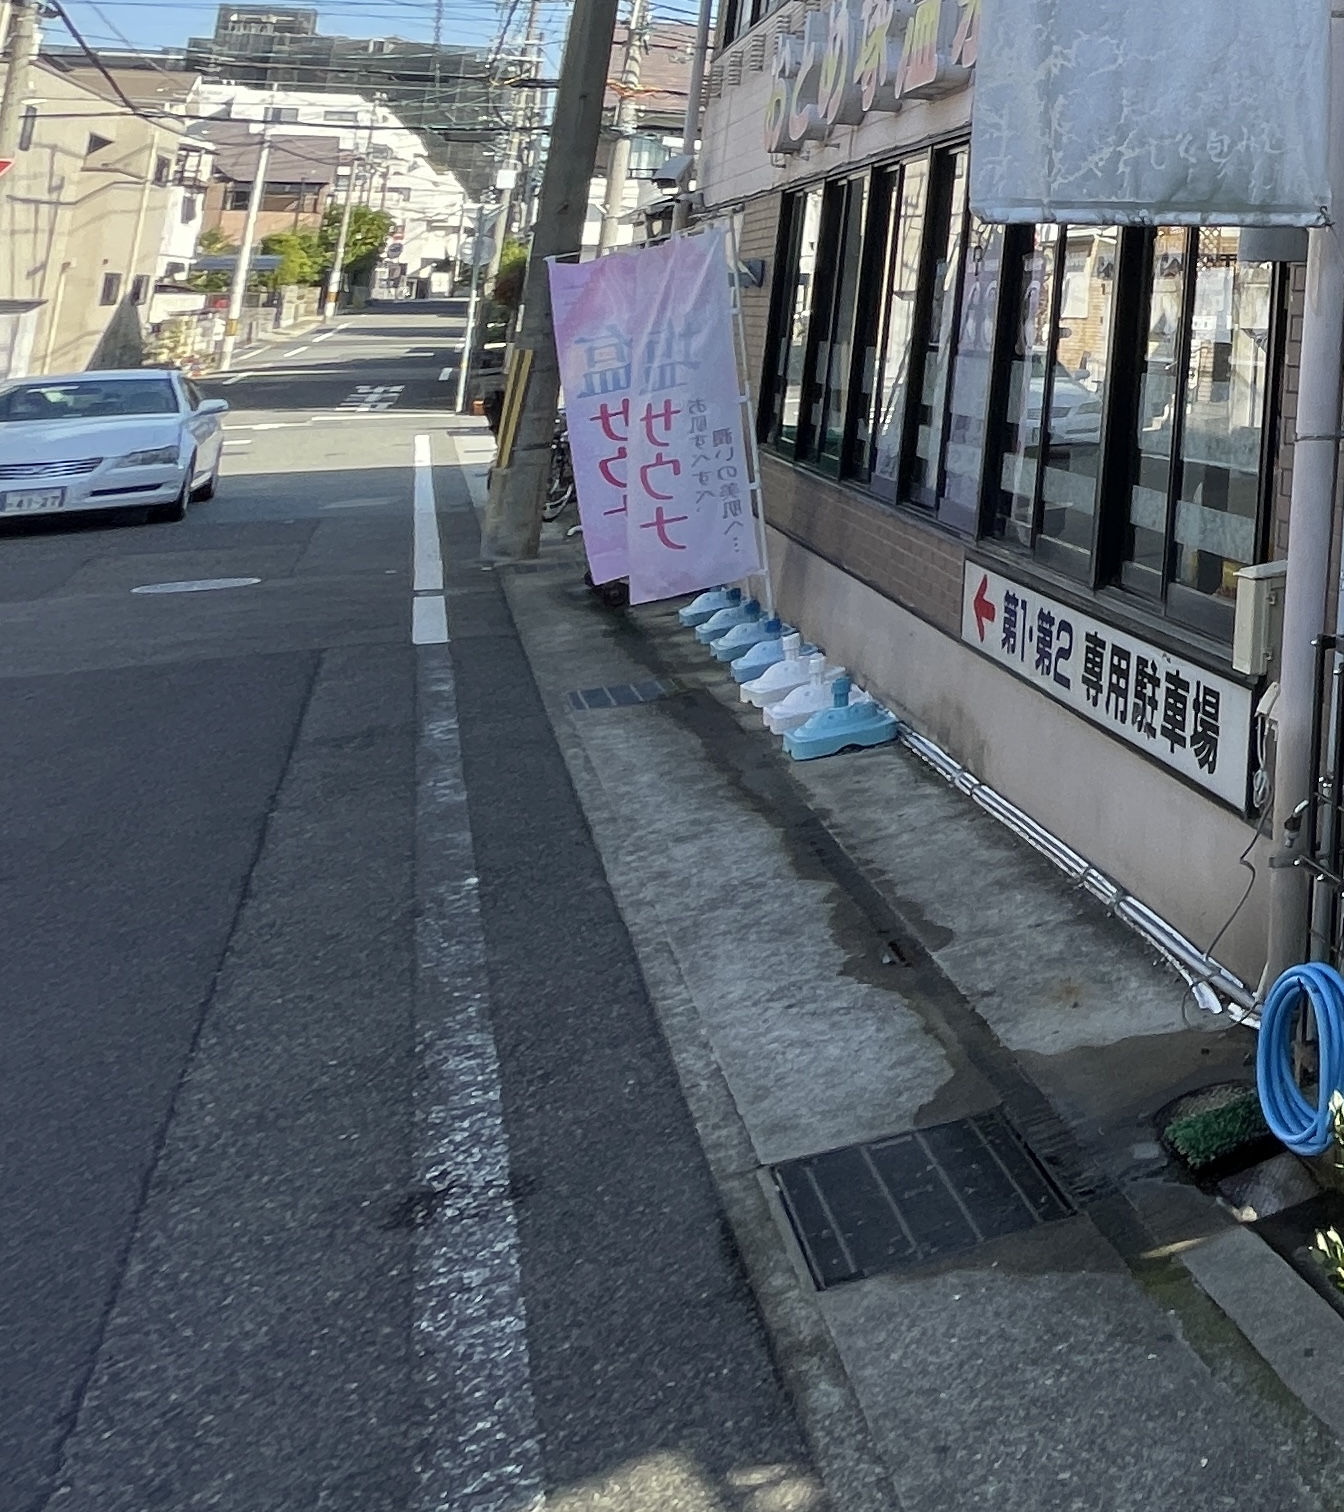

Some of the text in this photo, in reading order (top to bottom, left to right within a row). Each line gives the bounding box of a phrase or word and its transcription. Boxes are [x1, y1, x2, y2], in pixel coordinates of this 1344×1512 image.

[1081, 631, 1220, 774] 専用駐車場
